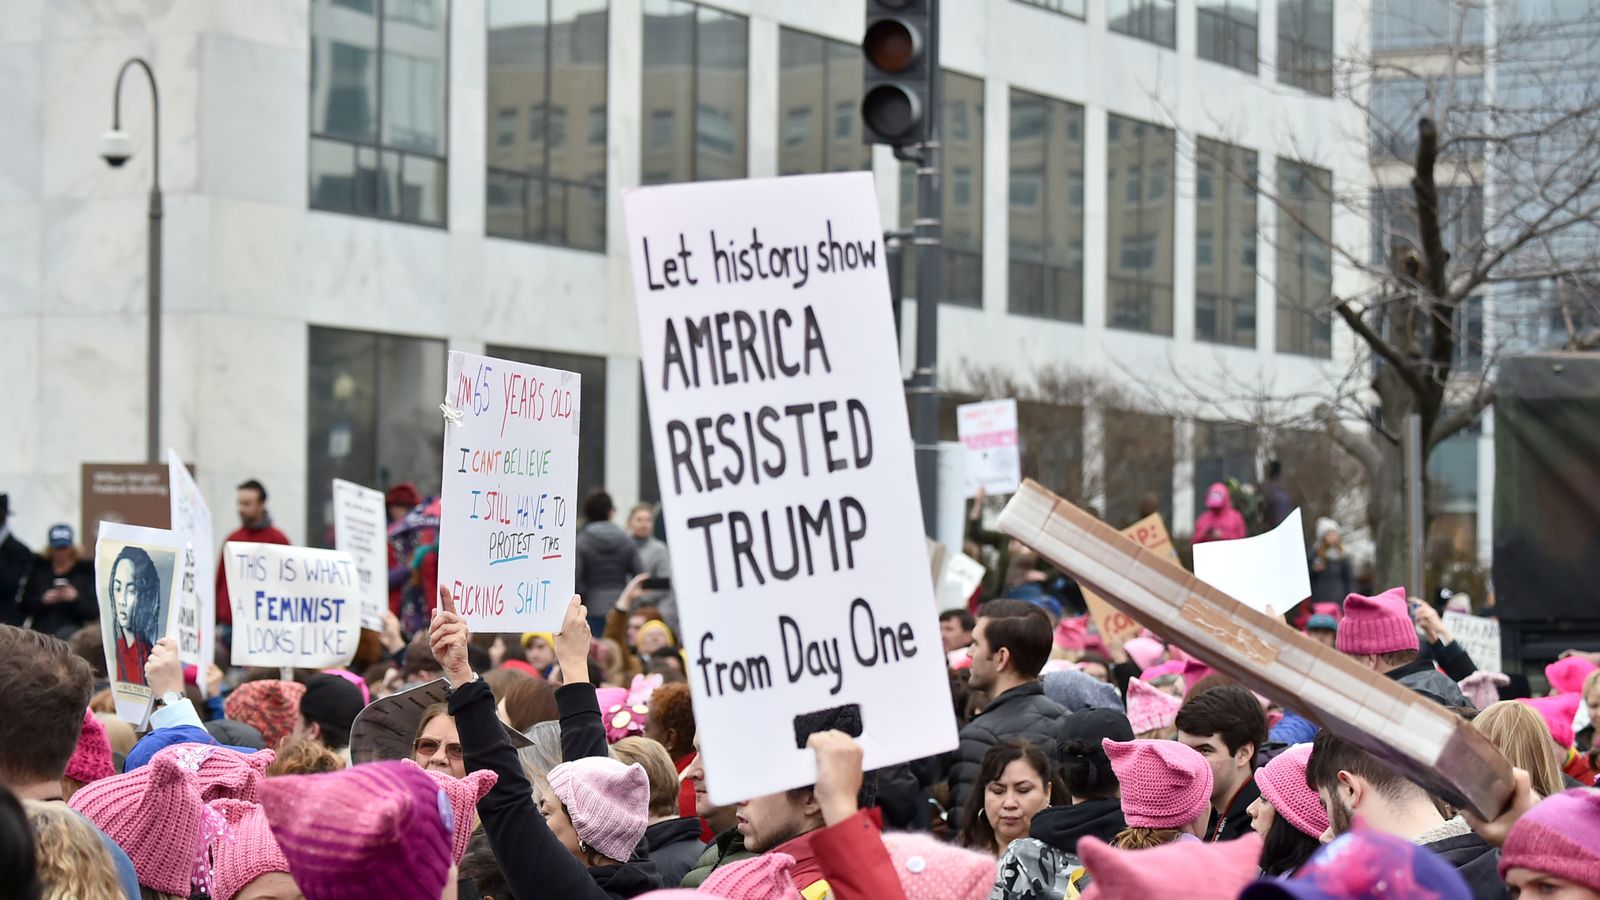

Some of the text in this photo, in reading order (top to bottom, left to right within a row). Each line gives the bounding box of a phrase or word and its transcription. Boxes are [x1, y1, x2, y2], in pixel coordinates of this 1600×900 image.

[643, 219, 876, 290] Let history show
[662, 305, 831, 391] AMERICA
[500, 372, 544, 437] YEARS
[550, 388, 572, 419] OLD
[458, 448, 469, 473] I
[503, 448, 551, 477] BELIEVE
[666, 399, 873, 495] RESISTED
[470, 490, 481, 519] I
[517, 493, 547, 529] HAVE
[553, 496, 566, 527] TO
[489, 531, 535, 559] PROTEST
[687, 496, 867, 592] TRUMP
[236, 554, 267, 582] THIS
[279, 557, 296, 582] IS
[303, 558, 351, 586] WHAT
[255, 591, 345, 623] FEMINIST
[453, 580, 504, 619] FUCKING
[246, 624, 347, 656] LOOKS LIKE
[697, 597, 917, 697] from Day One
